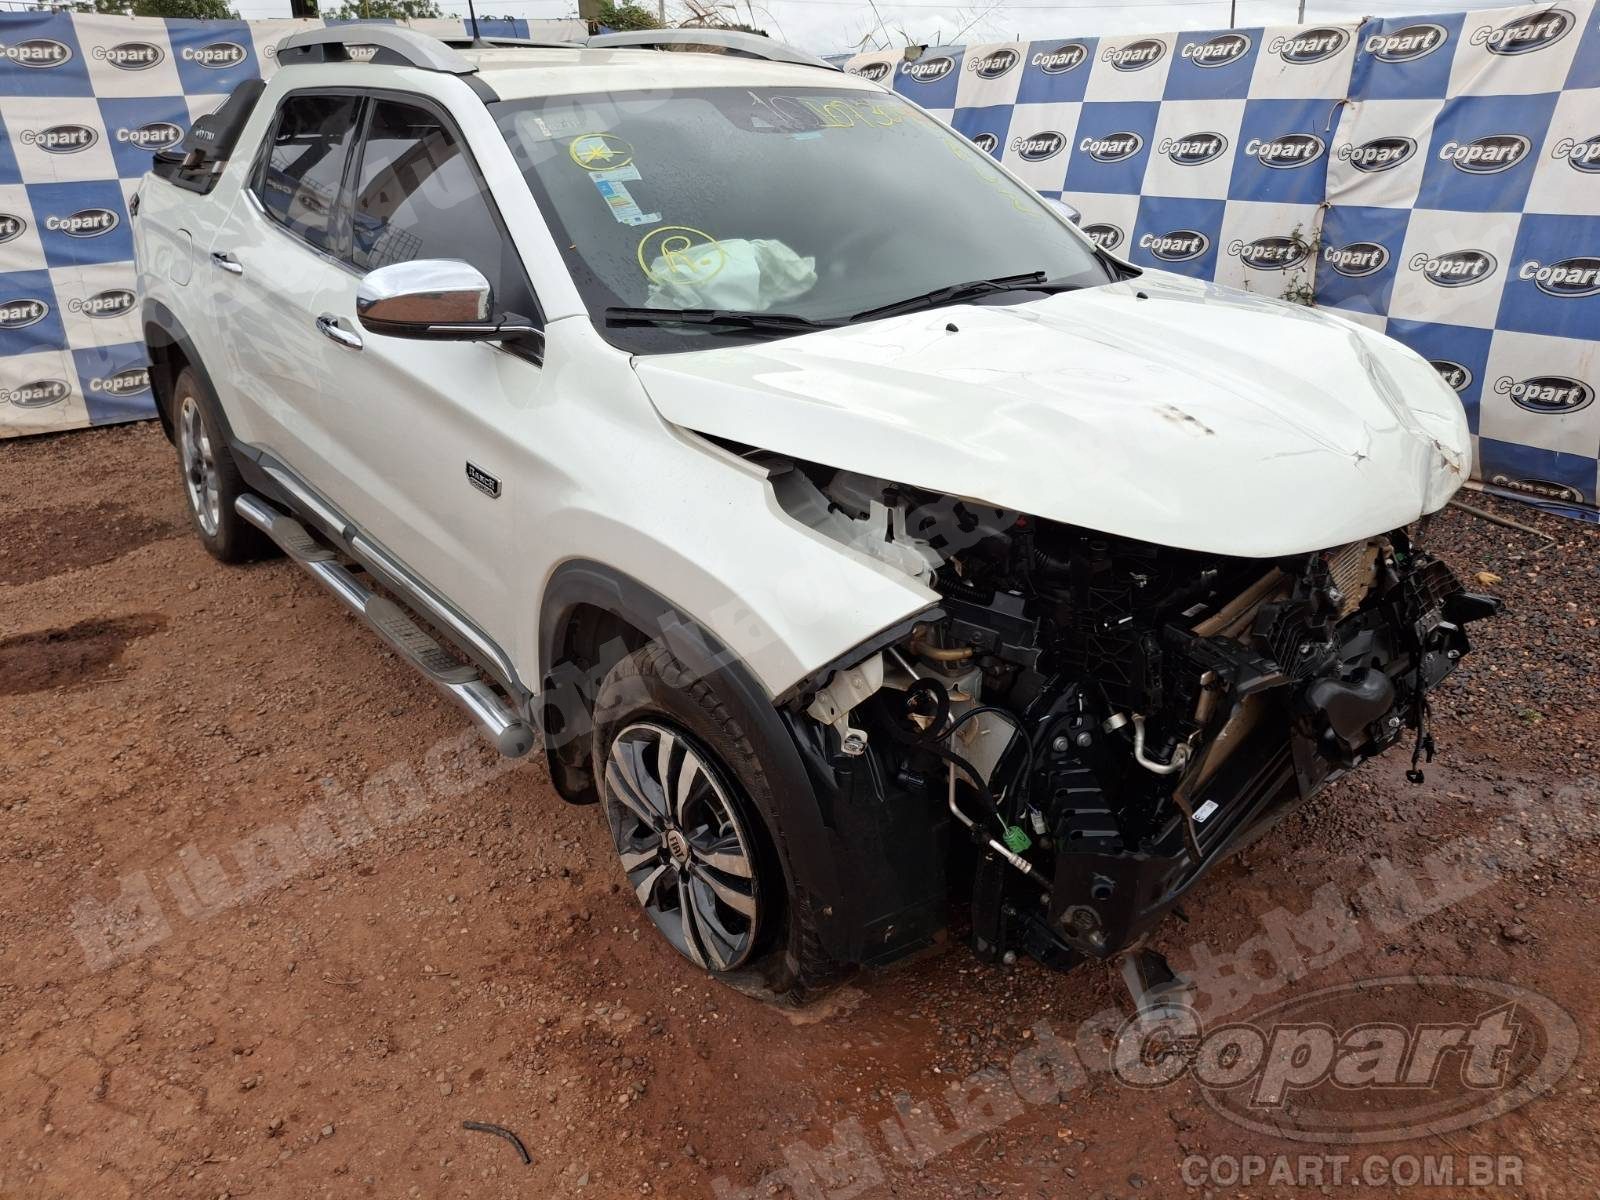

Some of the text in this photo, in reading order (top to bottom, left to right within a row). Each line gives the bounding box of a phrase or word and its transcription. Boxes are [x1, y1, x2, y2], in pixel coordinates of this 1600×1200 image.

[1470, 16, 1561, 47] Copart
[92, 46, 154, 63] Copart
[182, 46, 239, 63] Copart
[1182, 40, 1241, 62] Copart
[1268, 33, 1337, 56] Copart
[967, 52, 1012, 73] Copart
[1032, 48, 1080, 68] Copart
[1102, 45, 1158, 65] Copart
[901, 60, 949, 78] Copart
[20, 129, 88, 147] Copart
[116, 127, 175, 143] Copart
[1011, 137, 1058, 157] Copart
[1080, 137, 1135, 157] Copart
[1158, 138, 1217, 159] Copart
[1246, 139, 1317, 160] Copart
[1440, 142, 1520, 164] Copart
[1551, 138, 1600, 162] Cop
[46, 214, 110, 232] Copart
[1139, 233, 1200, 253] Copart
[1227, 239, 1297, 261] Copart
[1324, 246, 1380, 268] Copart
[1409, 252, 1487, 279] Copart
[0, 303, 38, 321] part
[68, 294, 130, 313] Copart
[90, 372, 150, 391] Copart
[1494, 375, 1581, 404] Copart
[0, 384, 60, 403] Copart
[669, 835, 685, 858] FIAT
